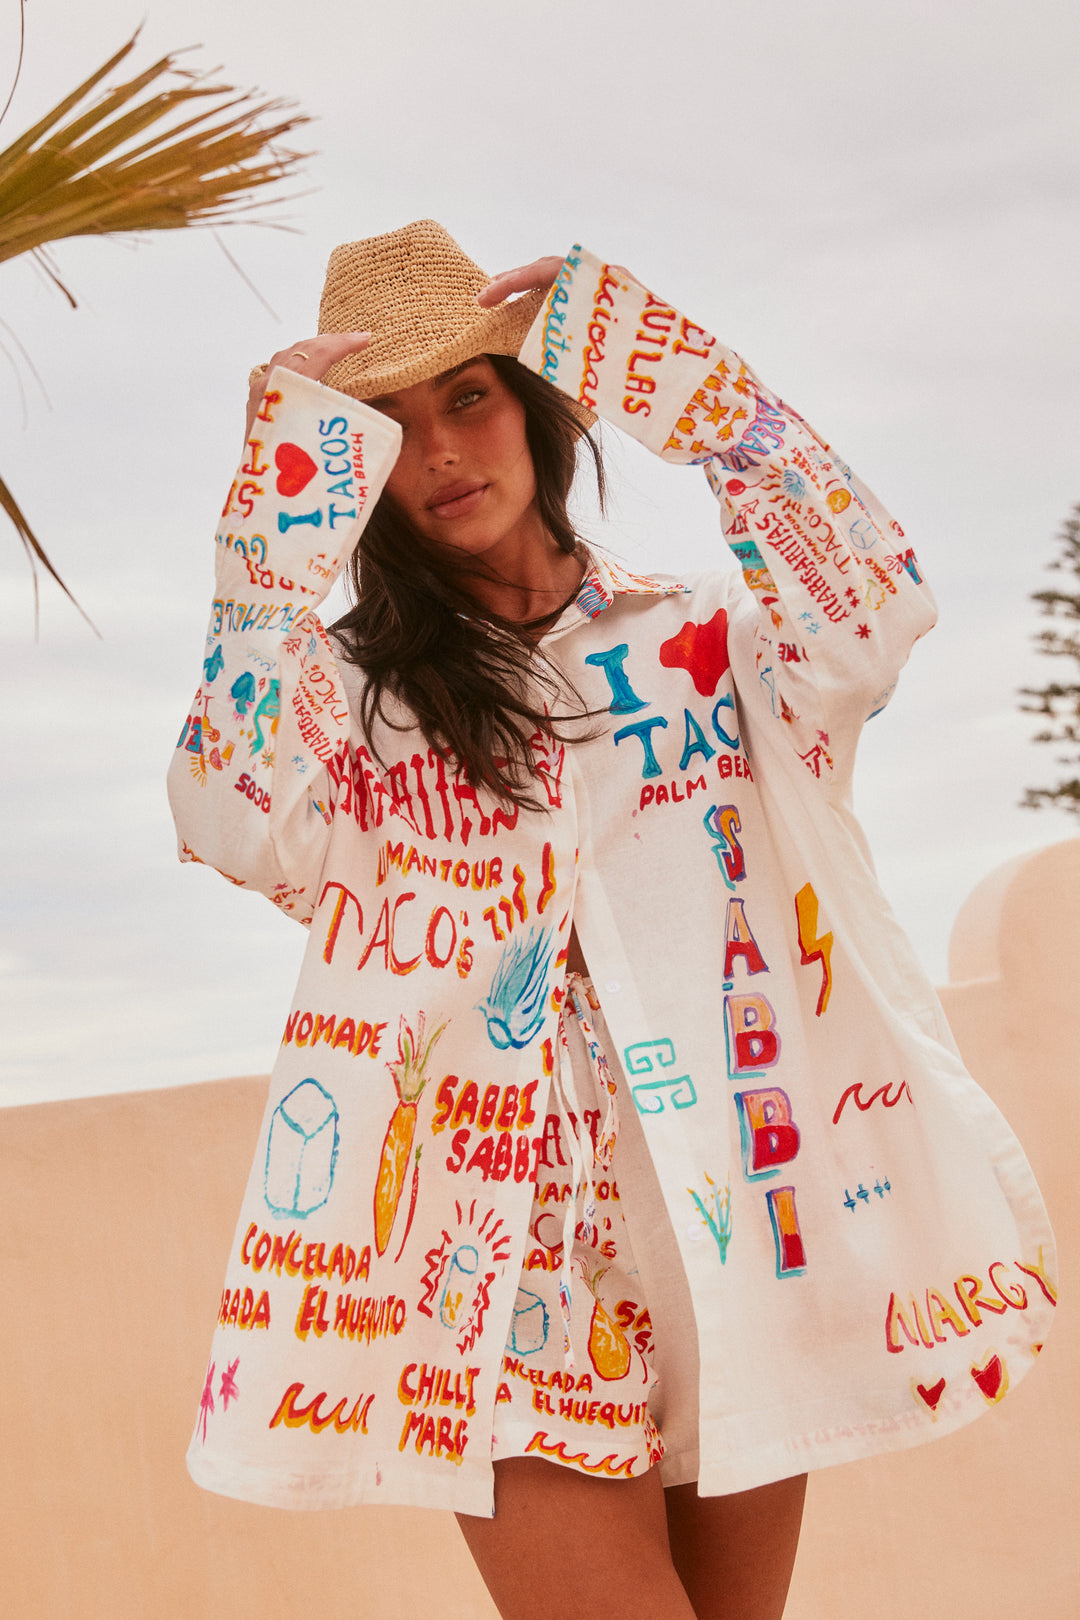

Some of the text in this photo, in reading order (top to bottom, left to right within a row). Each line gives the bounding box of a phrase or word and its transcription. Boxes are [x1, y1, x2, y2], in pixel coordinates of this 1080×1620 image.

[318, 415, 356, 530] TACOS
[350, 432, 367, 481] BEACH
[754, 511, 852, 624] MARGARITAS
[864, 557, 898, 595] CLASICO
[585, 643, 651, 716] I
[639, 774, 707, 811] PALM
[431, 1074, 539, 1136] SABBI
[446, 1128, 543, 1184] SABBI
[241, 1222, 372, 1287] CONCELADA
[398, 1409, 469, 1467] MARG
